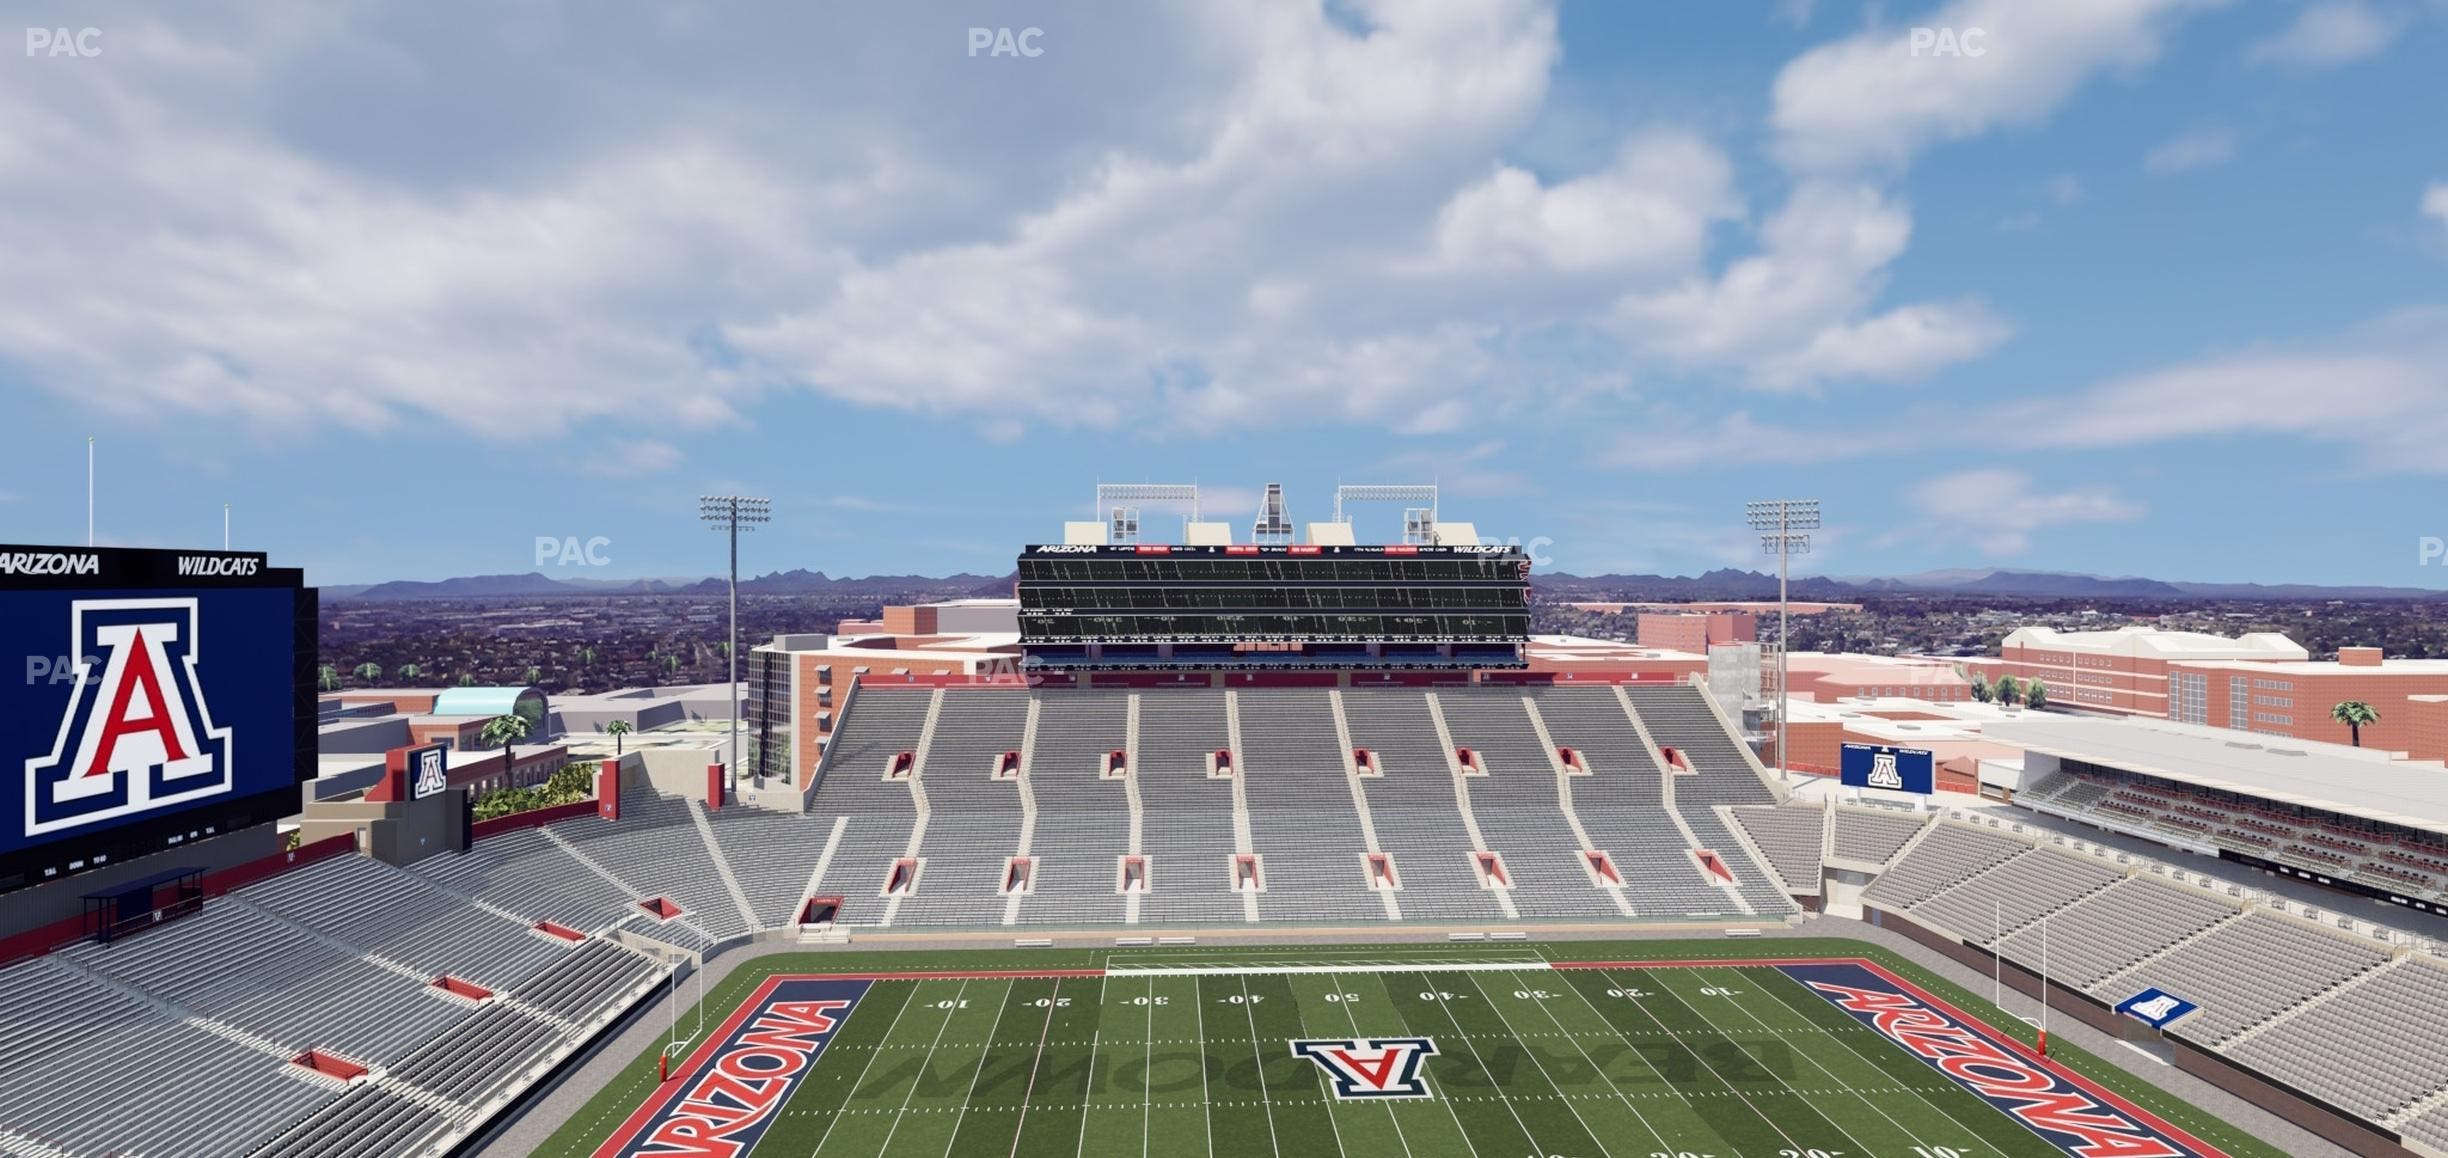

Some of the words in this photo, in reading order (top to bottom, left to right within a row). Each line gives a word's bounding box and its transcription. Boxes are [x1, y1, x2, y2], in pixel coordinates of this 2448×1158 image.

[1036, 545, 1097, 553] ARIZONA
[1452, 546, 1512, 554] WILDCATS
[0, 553, 99, 575] ARIZONA
[178, 556, 259, 576] WILDCATS
[25, 596, 233, 837] A
[415, 748, 447, 800] A
[1867, 753, 1903, 789] A
[1287, 1037, 1441, 1101] A
